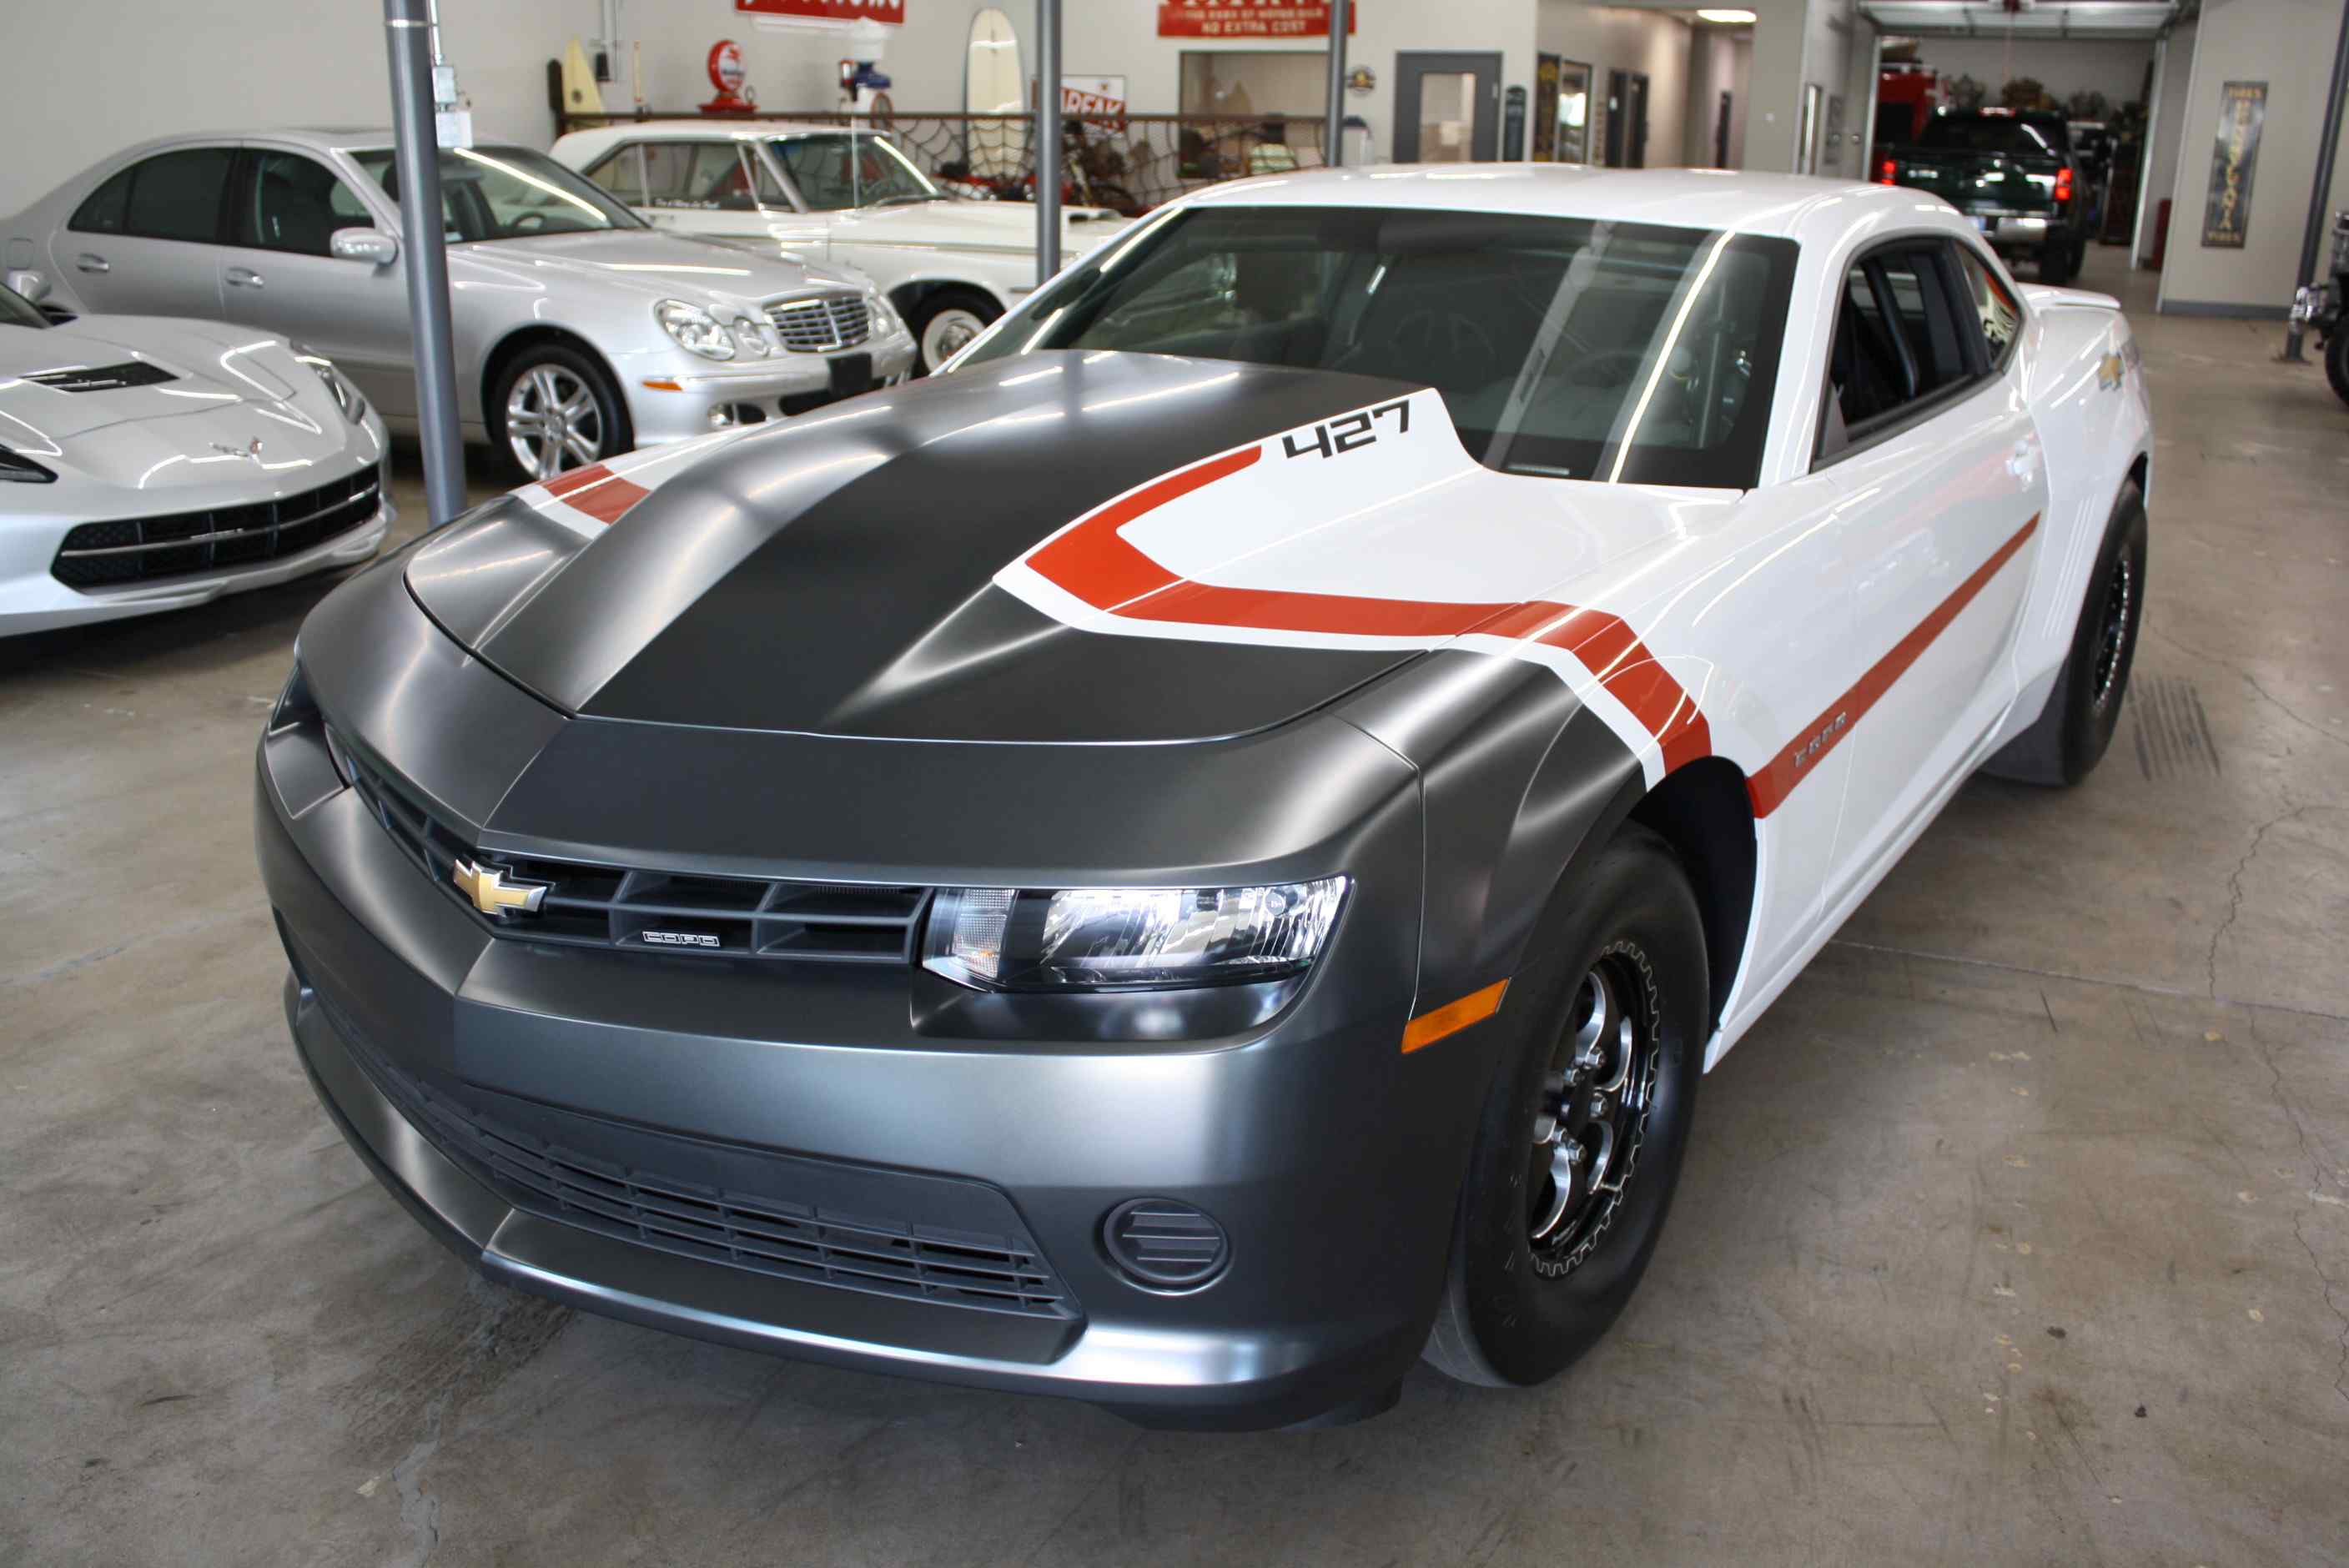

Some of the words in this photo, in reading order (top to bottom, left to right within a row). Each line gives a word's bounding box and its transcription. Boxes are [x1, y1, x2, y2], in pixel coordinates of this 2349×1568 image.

[1224, 20, 1268, 33] EXTRA
[1271, 20, 1306, 33] COST
[1281, 399, 1410, 459] 427
[641, 931, 720, 947] COPO
